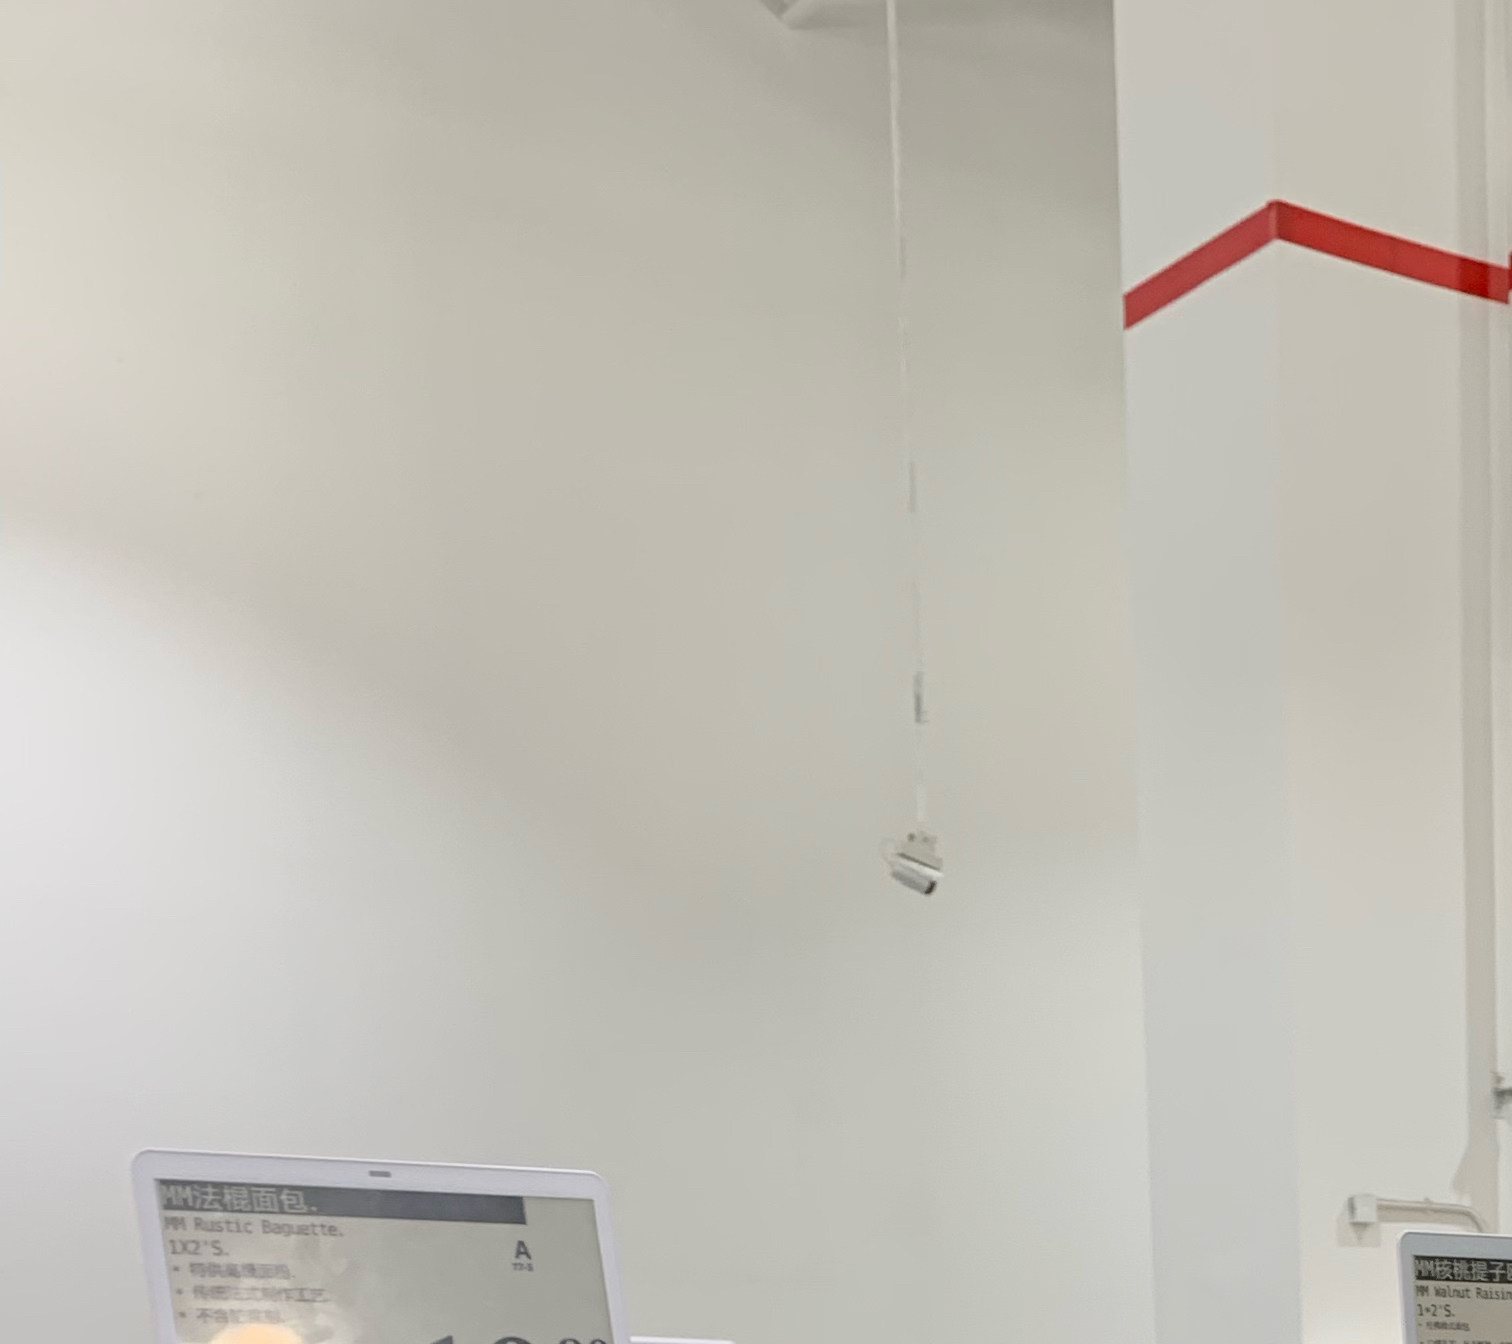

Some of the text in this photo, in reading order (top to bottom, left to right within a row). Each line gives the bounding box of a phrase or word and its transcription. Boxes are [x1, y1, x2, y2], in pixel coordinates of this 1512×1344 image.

[194, 1217, 253, 1235] Rustic
[514, 1239, 533, 1261] A
[1434, 1286, 1471, 1299] Walnut
